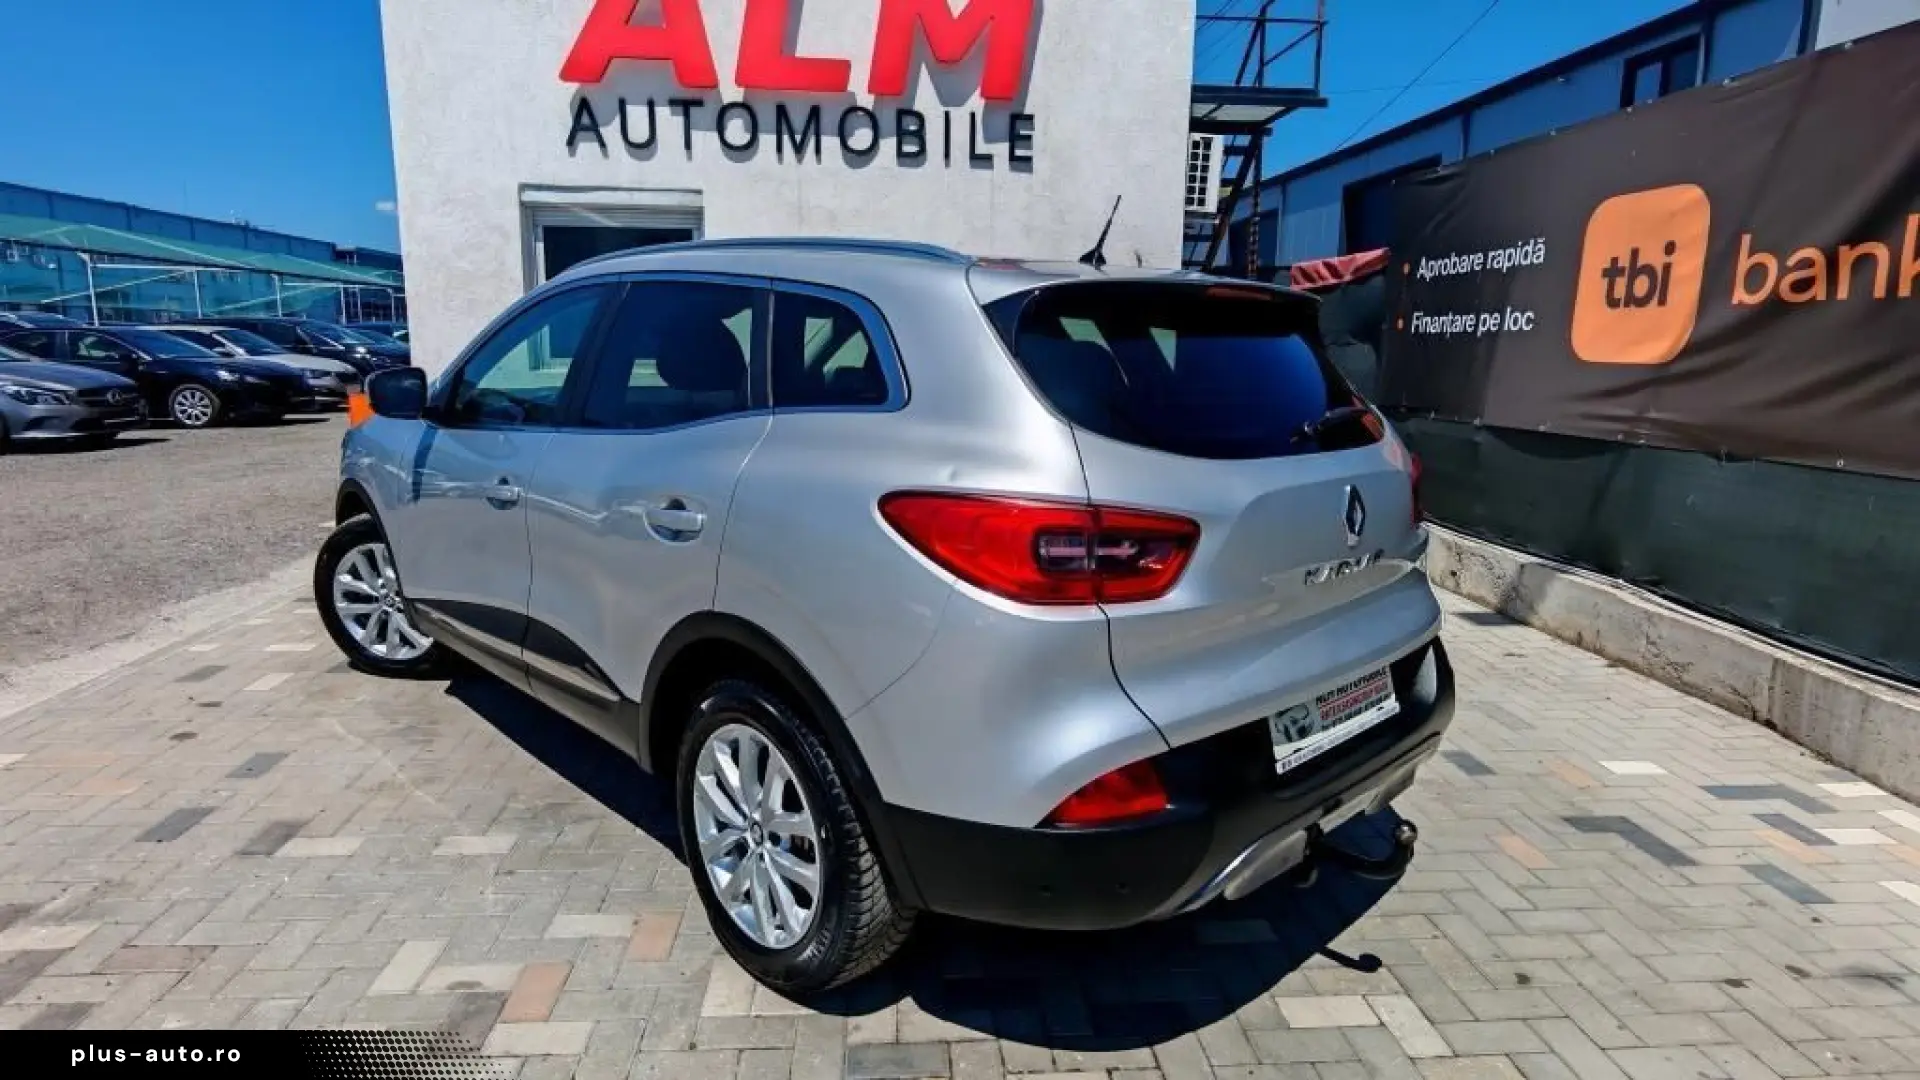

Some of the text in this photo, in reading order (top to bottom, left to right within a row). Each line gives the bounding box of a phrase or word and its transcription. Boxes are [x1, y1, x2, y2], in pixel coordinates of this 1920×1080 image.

[558, 0, 1033, 100] ALM
[566, 97, 1034, 164] AUTOMOBILE
[1417, 238, 1545, 282] Aprobare rapidă
[1602, 240, 1676, 309] tbi
[1411, 306, 1534, 338] Finanțare pe loc
